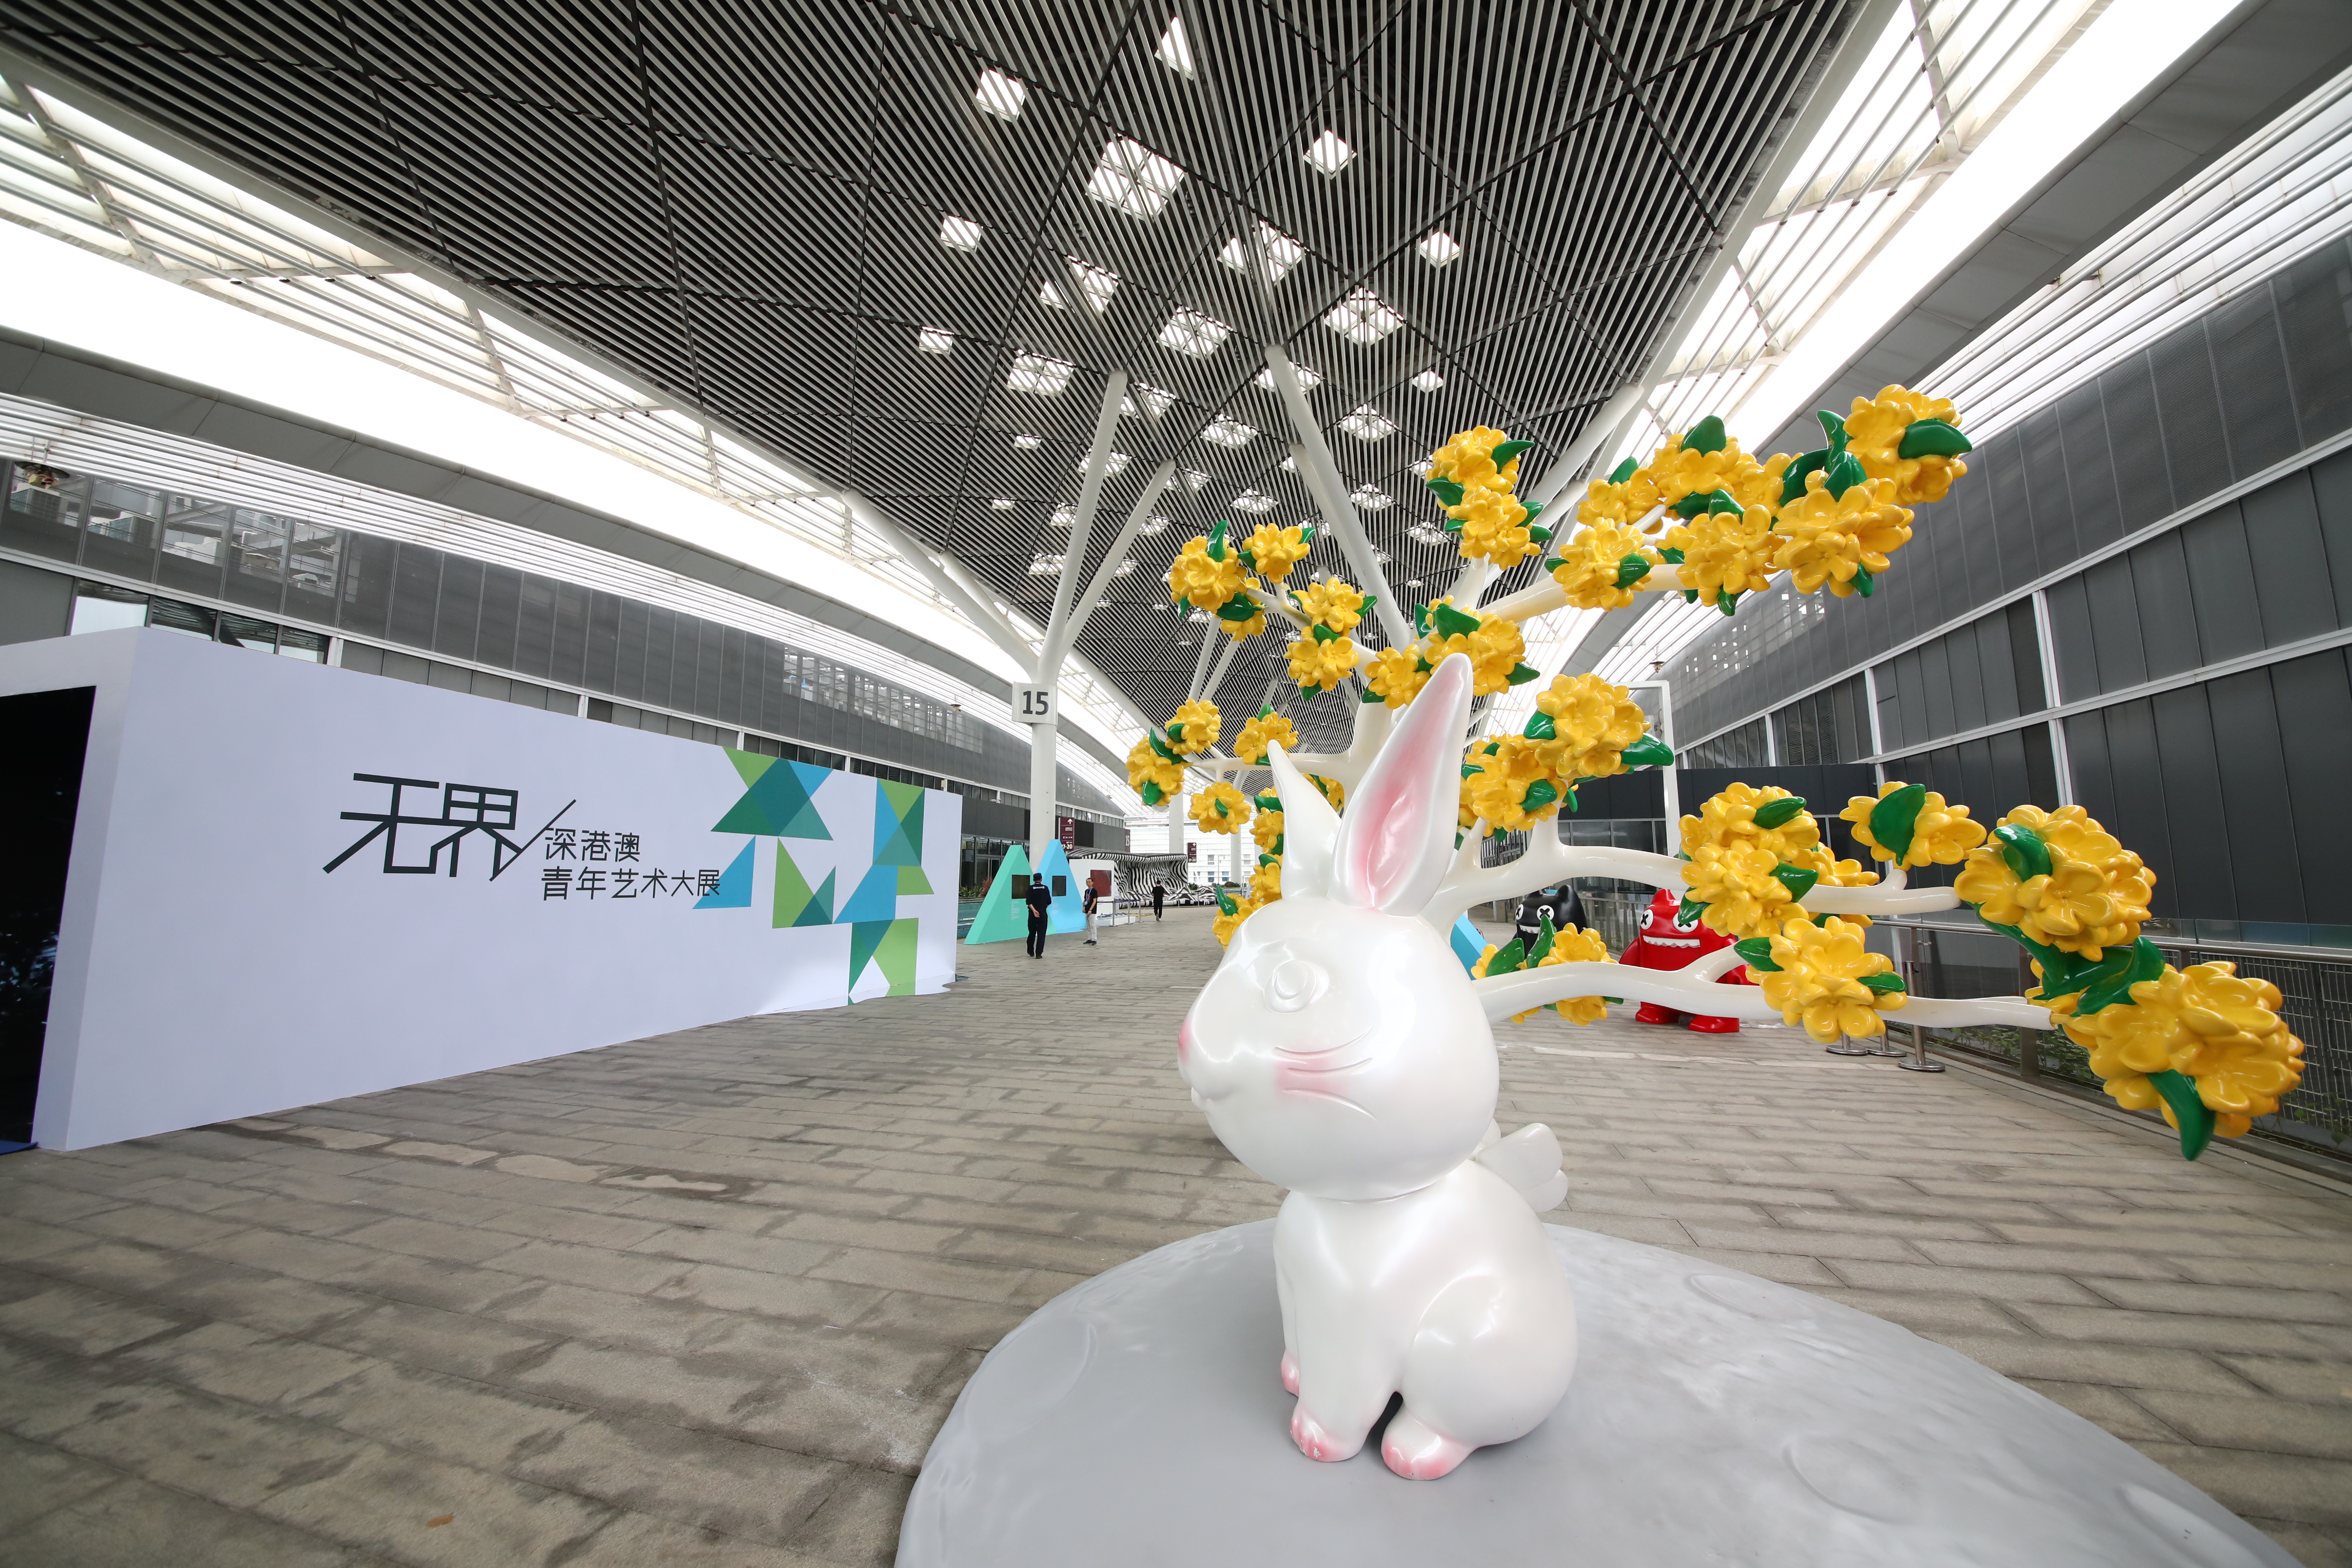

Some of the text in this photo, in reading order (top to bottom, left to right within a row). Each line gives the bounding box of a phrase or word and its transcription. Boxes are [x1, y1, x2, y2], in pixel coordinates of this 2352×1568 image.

[1022, 690, 1049, 716] 15
[544, 827, 641, 863] 深港澳
[541, 866, 721, 901] 青年艺术大展
